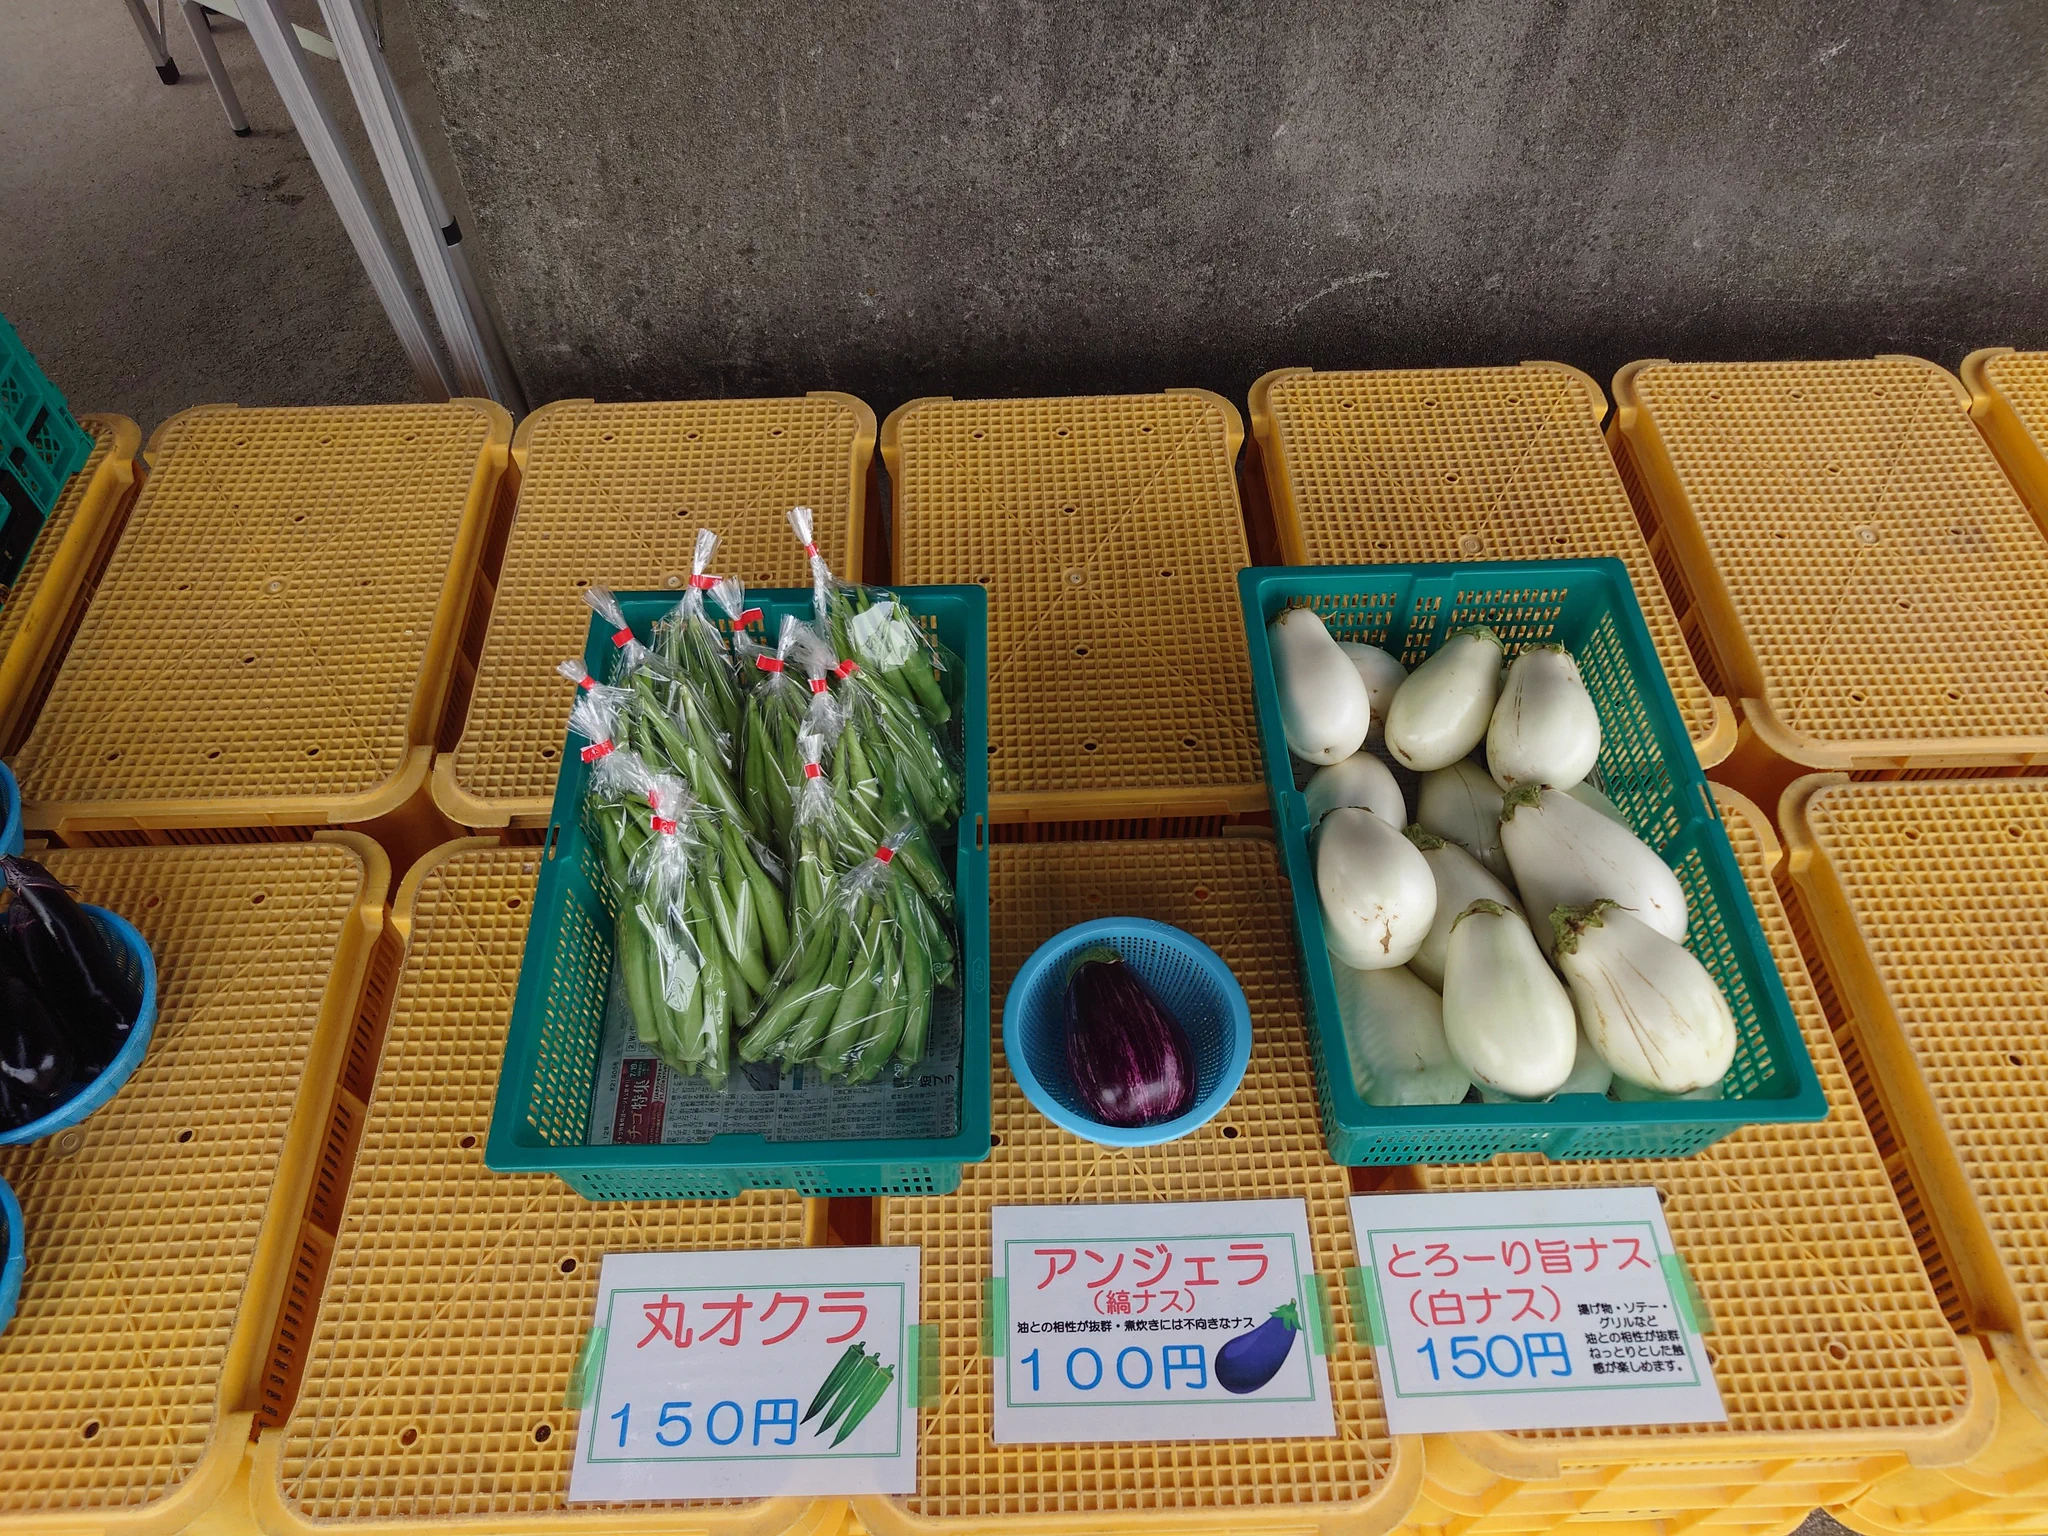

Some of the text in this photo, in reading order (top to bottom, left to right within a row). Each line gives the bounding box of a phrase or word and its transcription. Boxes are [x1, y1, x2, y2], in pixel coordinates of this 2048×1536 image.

[1034, 1243, 1269, 1290] アンジェラ
[1387, 1236, 1652, 1278] とろーり旨ナス
[636, 1291, 868, 1349] 丸オクラ
[1093, 1287, 1196, 1315] （縞ナス）
[1409, 1285, 1561, 1327] （白ナス）
[1599, 1315, 1659, 1329] グリルなど
[1017, 1316, 1255, 1334] 油との相性が抜群・煮炊きには不向きなナス
[1584, 1330, 1681, 1344] 油との相性が抜群
[1021, 1344, 1208, 1391] 100円
[1416, 1331, 1573, 1381] 150円
[610, 1398, 800, 1449] 150円
